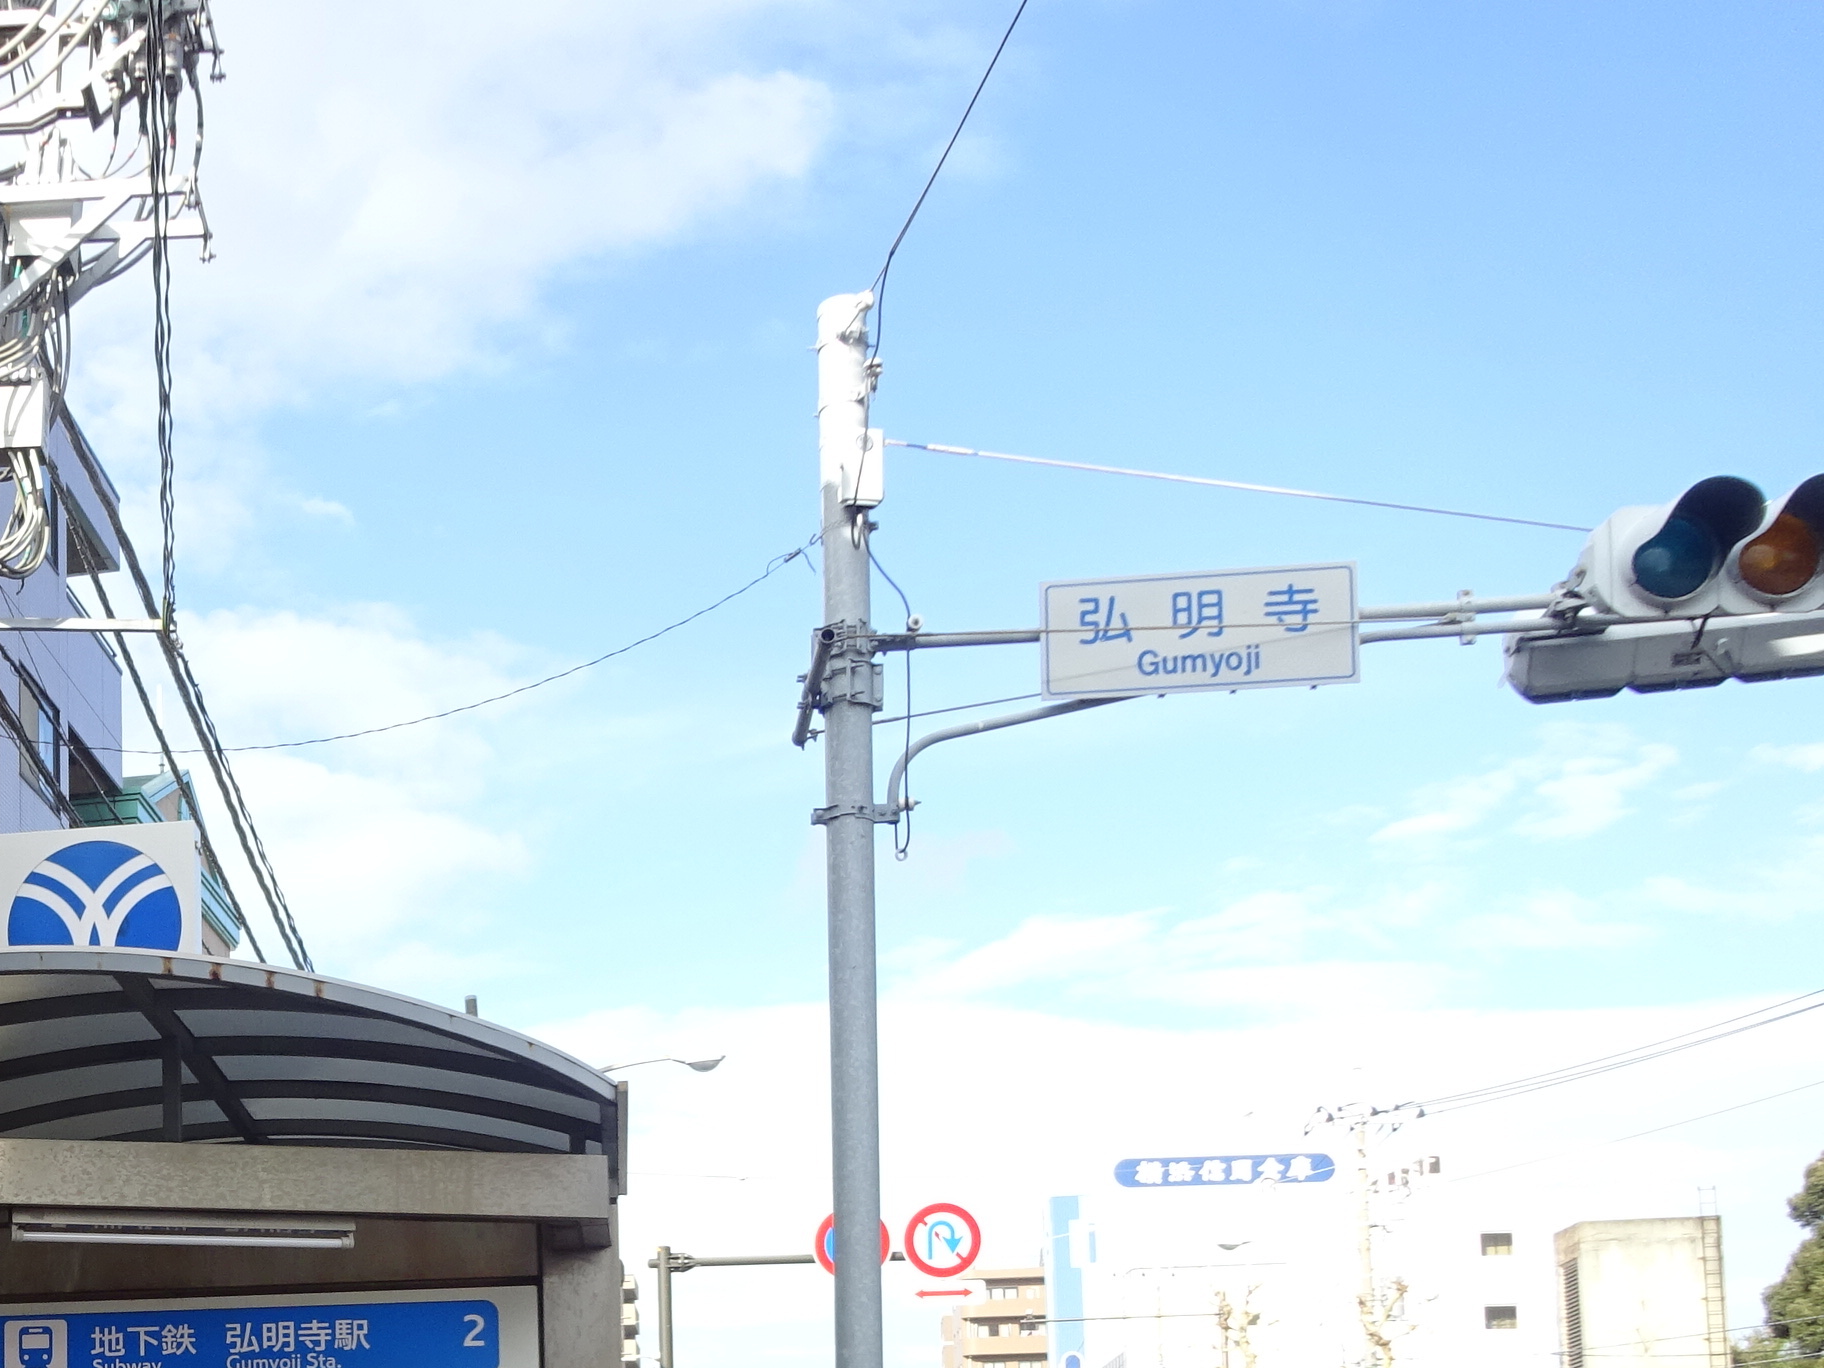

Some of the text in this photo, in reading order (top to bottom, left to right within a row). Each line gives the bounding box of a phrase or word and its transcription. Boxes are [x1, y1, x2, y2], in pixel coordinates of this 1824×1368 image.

[1078, 583, 1319, 645] 弘明寺
[1136, 643, 1262, 678] Gumyoji
[90, 1313, 487, 1358] 地下鉄 弘明寺駅 2
